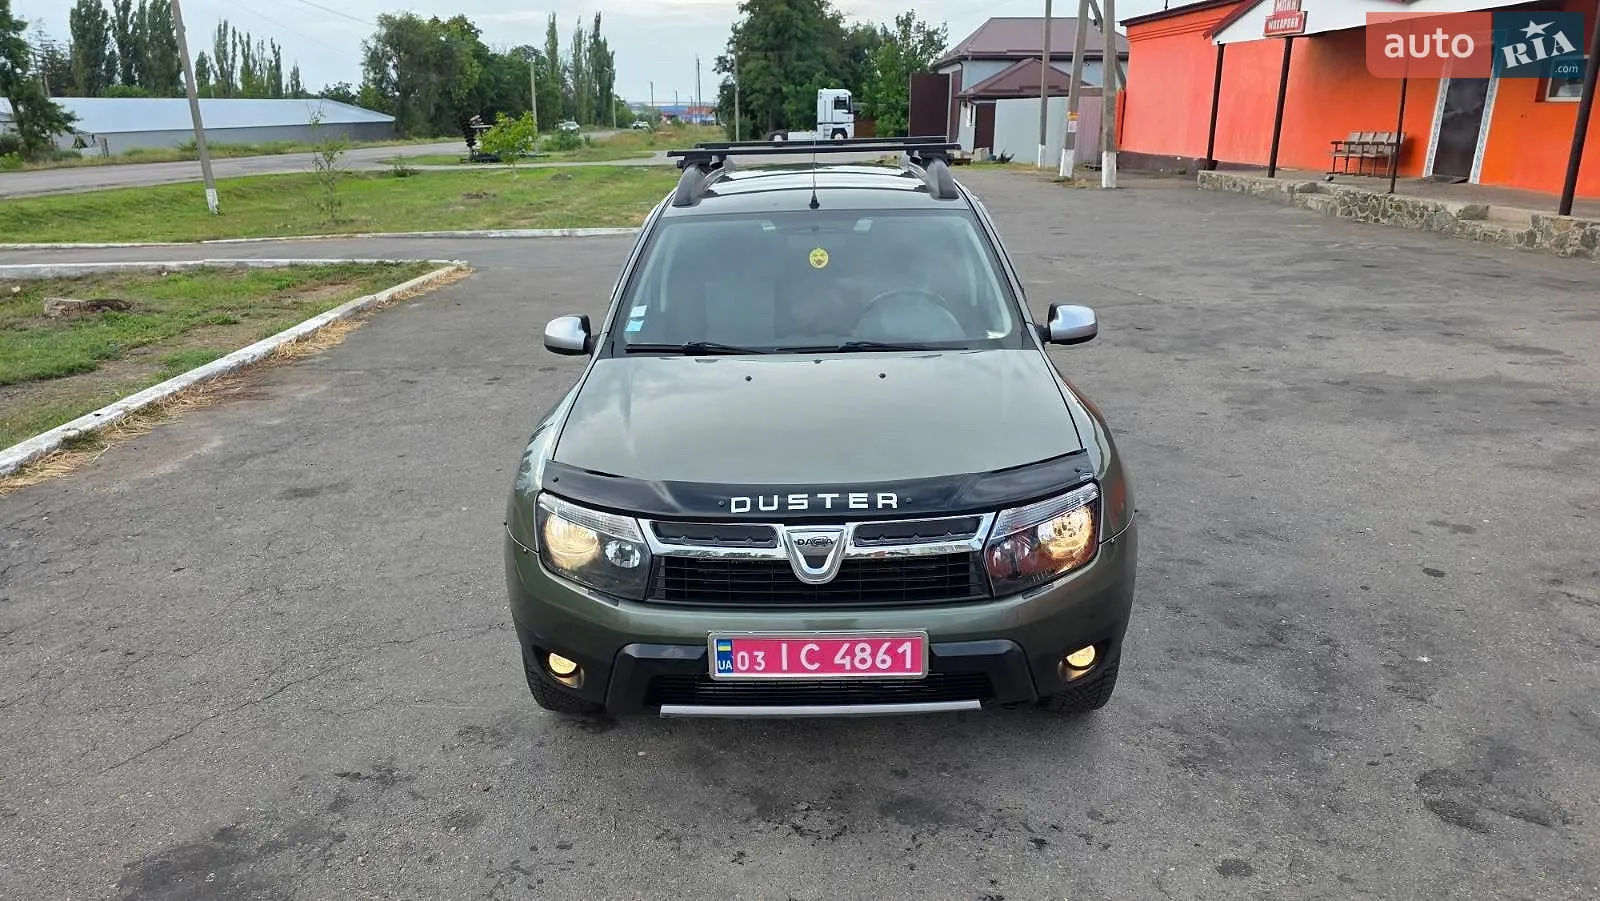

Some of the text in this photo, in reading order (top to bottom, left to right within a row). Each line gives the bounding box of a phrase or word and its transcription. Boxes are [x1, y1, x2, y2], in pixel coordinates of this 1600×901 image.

[730, 492, 898, 513] DUSTER
[796, 538, 834, 546] DACIA
[736, 650, 766, 671] 03
[833, 641, 912, 670] 4861
[718, 659, 733, 670] UA
